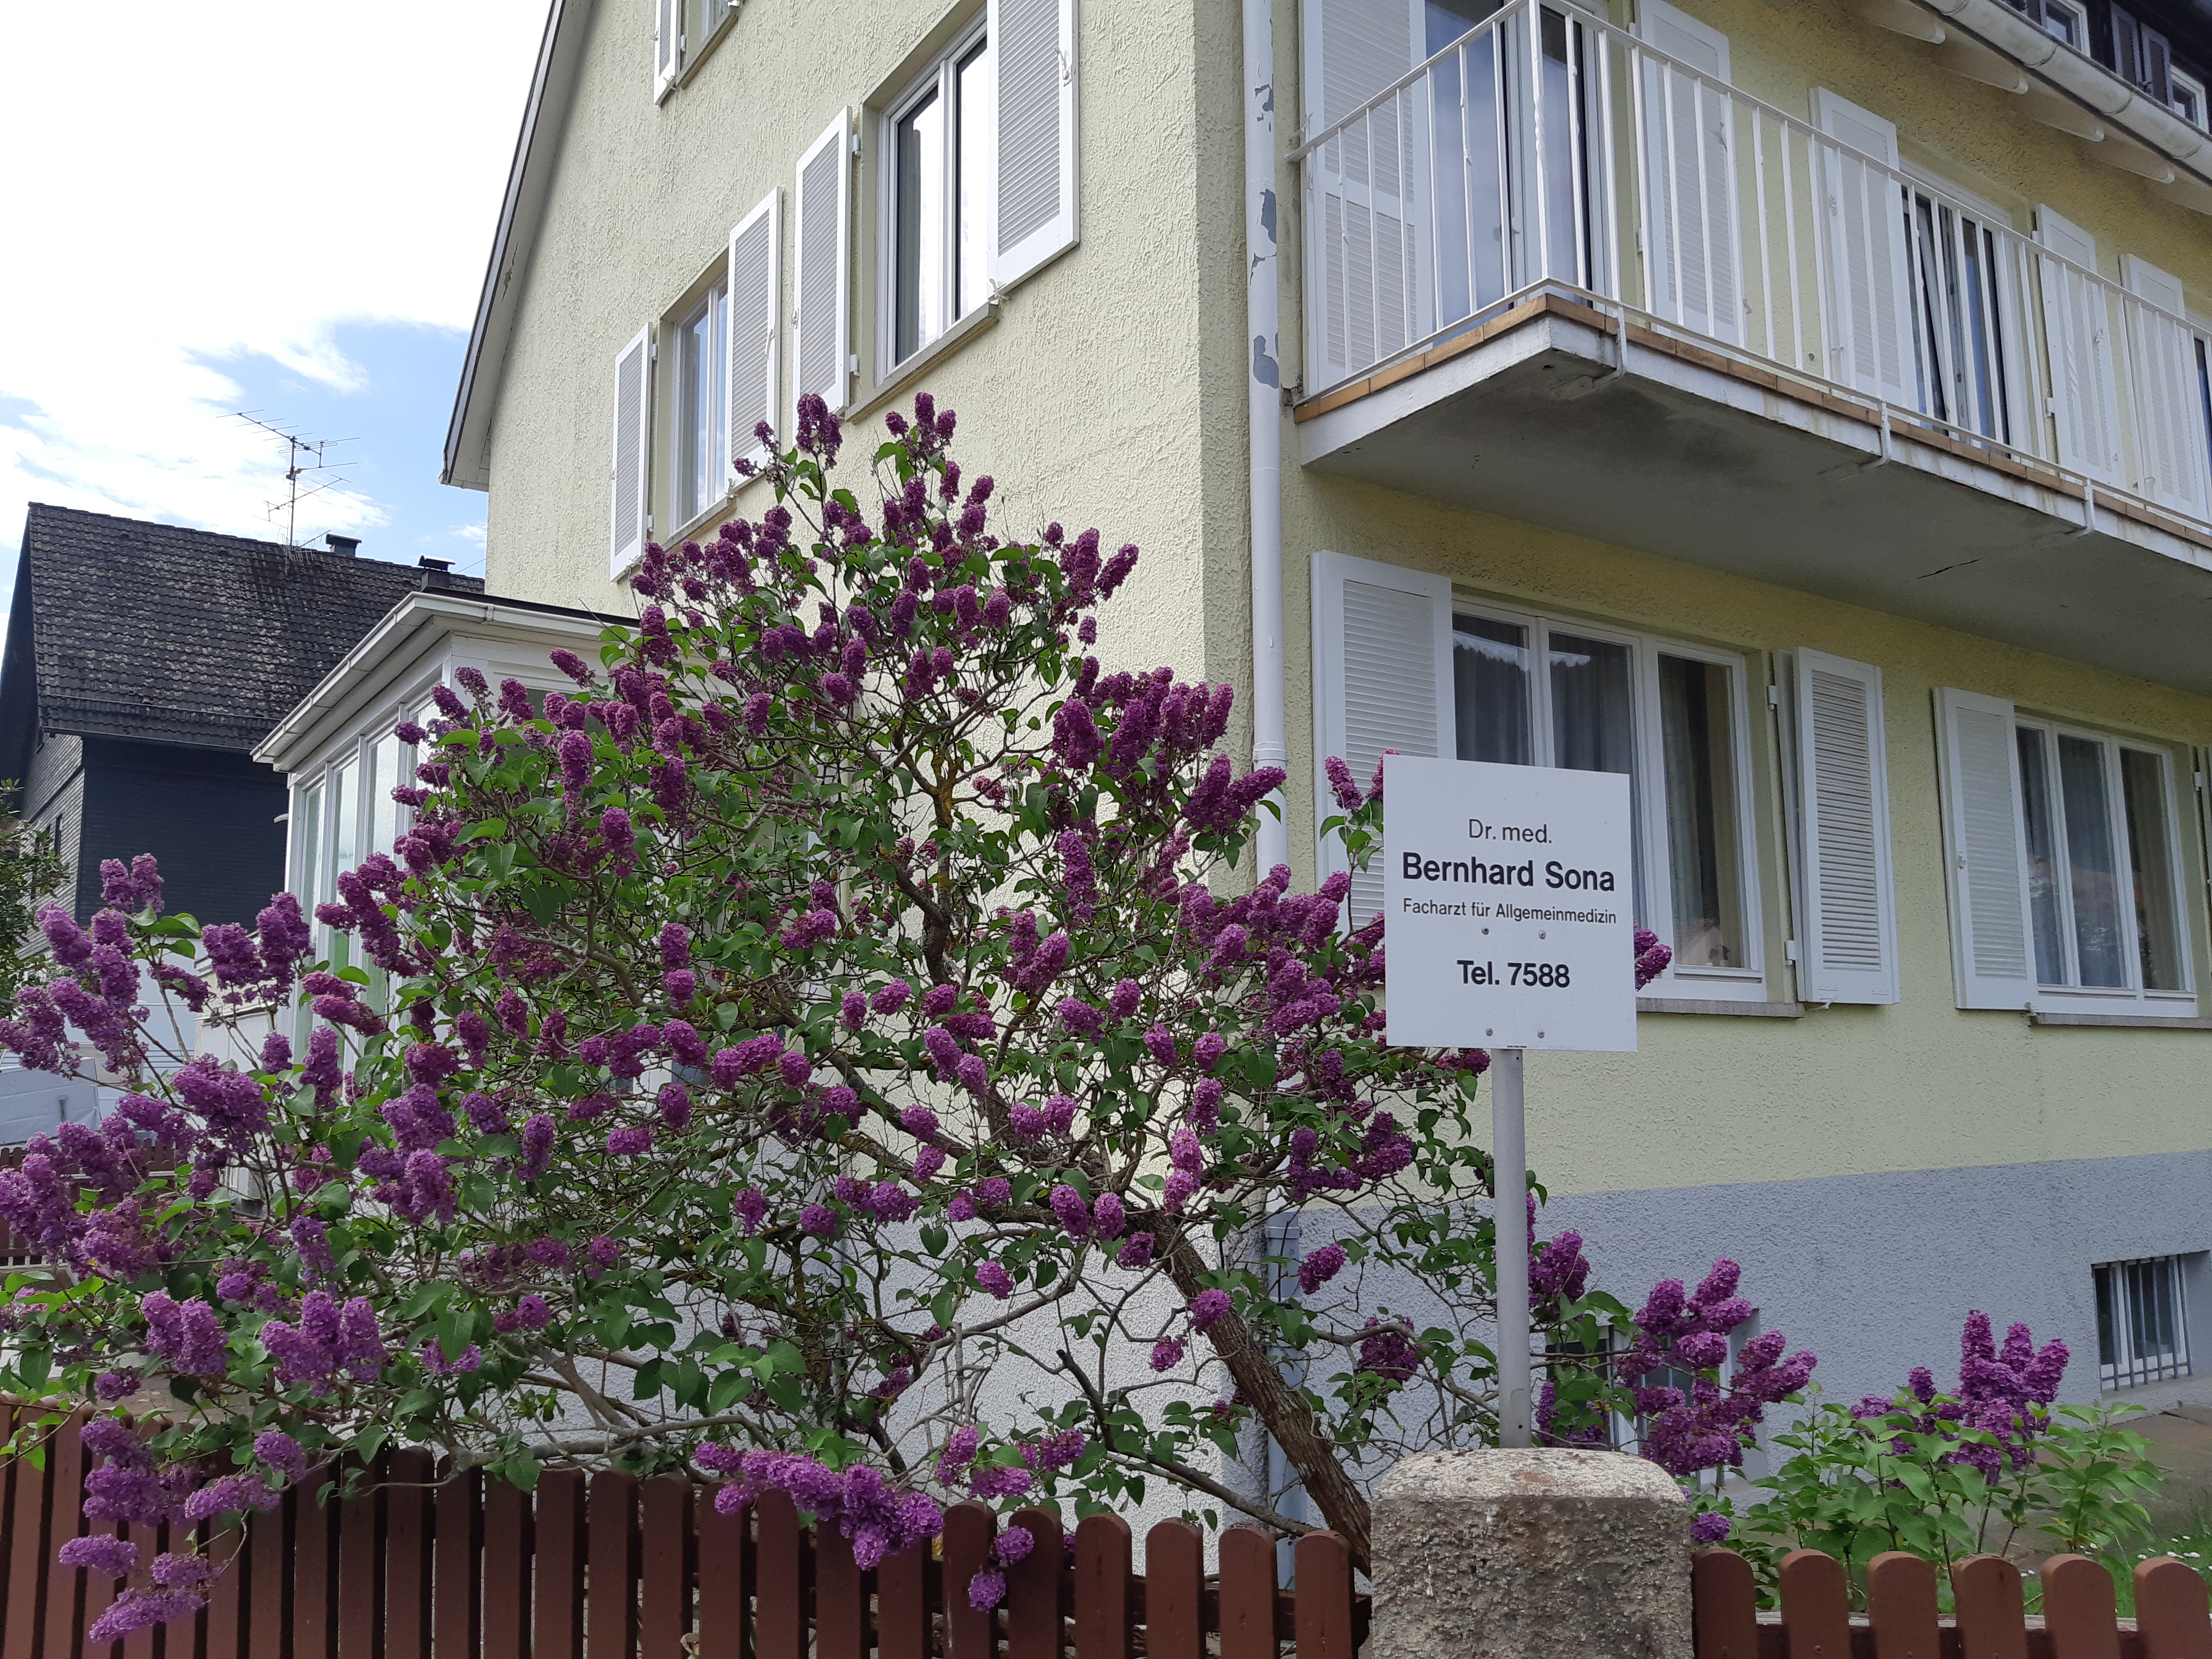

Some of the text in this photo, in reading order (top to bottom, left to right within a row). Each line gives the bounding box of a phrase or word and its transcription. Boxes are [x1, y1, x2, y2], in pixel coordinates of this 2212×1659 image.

[1468, 818, 1552, 844] Dr. med.
[1402, 852, 1615, 892] Bernhard Sona
[1403, 898, 1616, 924] Facharzt für Allgemeinmedizin
[1456, 960, 1570, 988] Tel. 7588
